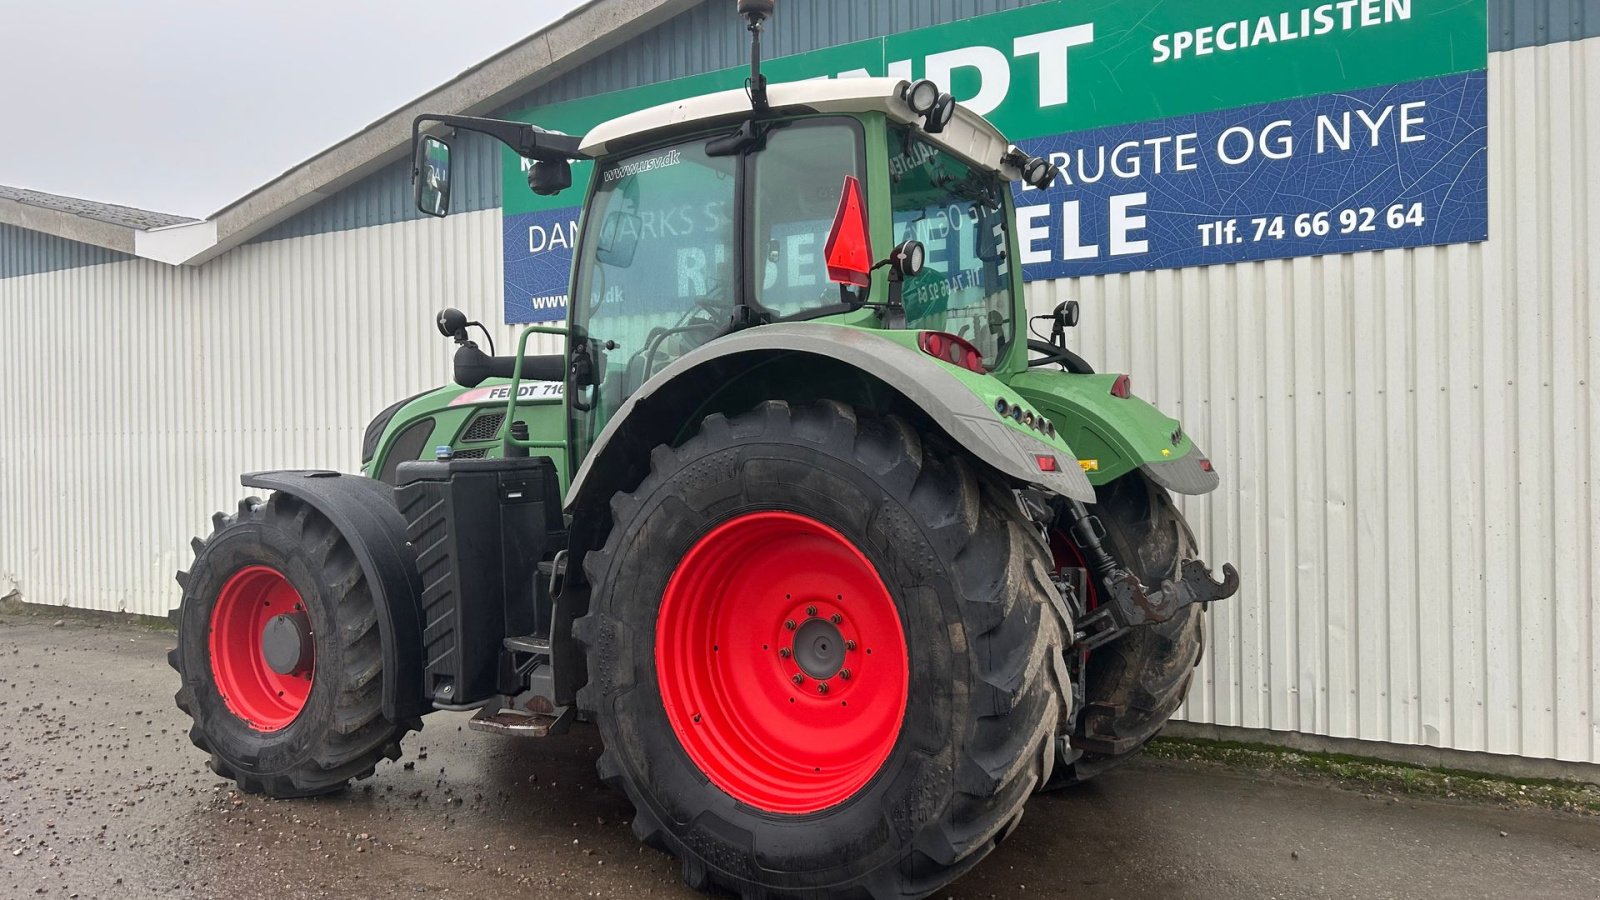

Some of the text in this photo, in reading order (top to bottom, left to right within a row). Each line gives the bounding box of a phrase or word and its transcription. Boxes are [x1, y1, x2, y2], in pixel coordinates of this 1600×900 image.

[1152, 0, 1411, 63] SPECIALISTEN
[603, 149, 681, 182] www.usv.dk
[1022, 132, 1197, 191] RUGTE
[1217, 120, 1292, 165] OG
[1317, 101, 1426, 154] NYE
[1198, 203, 1424, 247] Tlf. 74 66 92 64
[489, 386, 537, 399] FEDT
